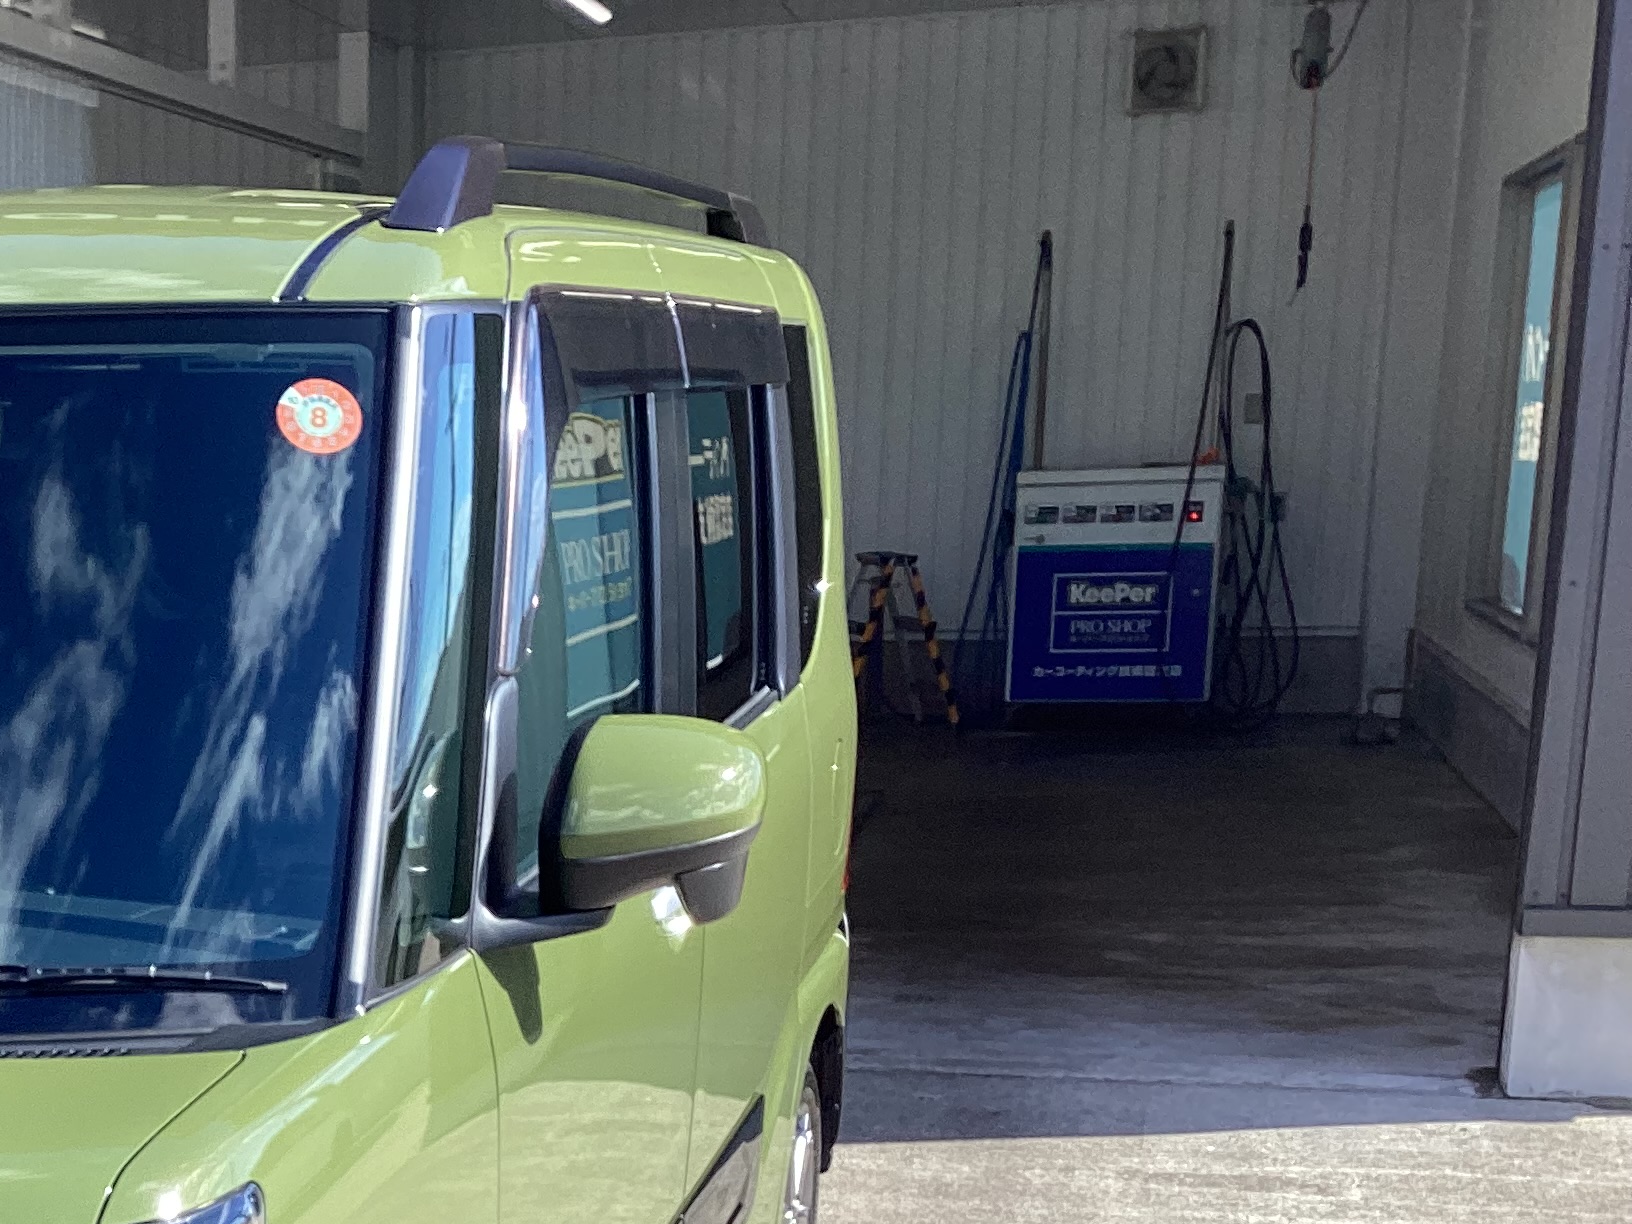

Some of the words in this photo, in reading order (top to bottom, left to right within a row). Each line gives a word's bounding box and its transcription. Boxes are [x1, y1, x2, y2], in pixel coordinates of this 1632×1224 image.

[311, 407, 327, 428] 8
[1068, 582, 1158, 605] KeePer
[1070, 619, 1104, 633] PRO
[1107, 619, 1152, 633] SHOP
